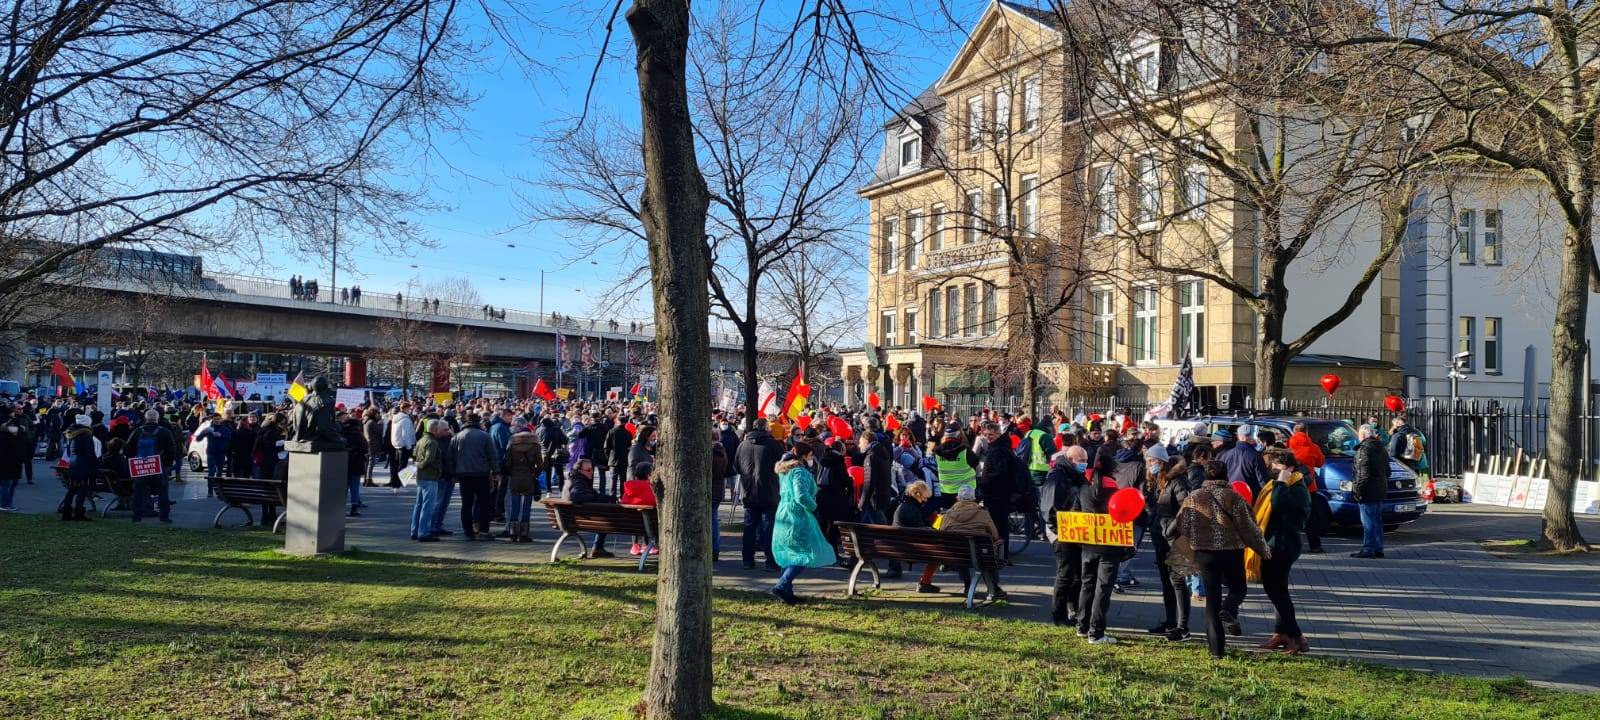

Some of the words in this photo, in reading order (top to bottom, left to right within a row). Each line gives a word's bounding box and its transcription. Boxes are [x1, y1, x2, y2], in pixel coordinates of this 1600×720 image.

[1061, 514, 1079, 525] WIR
[1083, 514, 1106, 526] SIND
[1060, 526, 1089, 541] ROTE
[1094, 528, 1133, 544] LINIE
